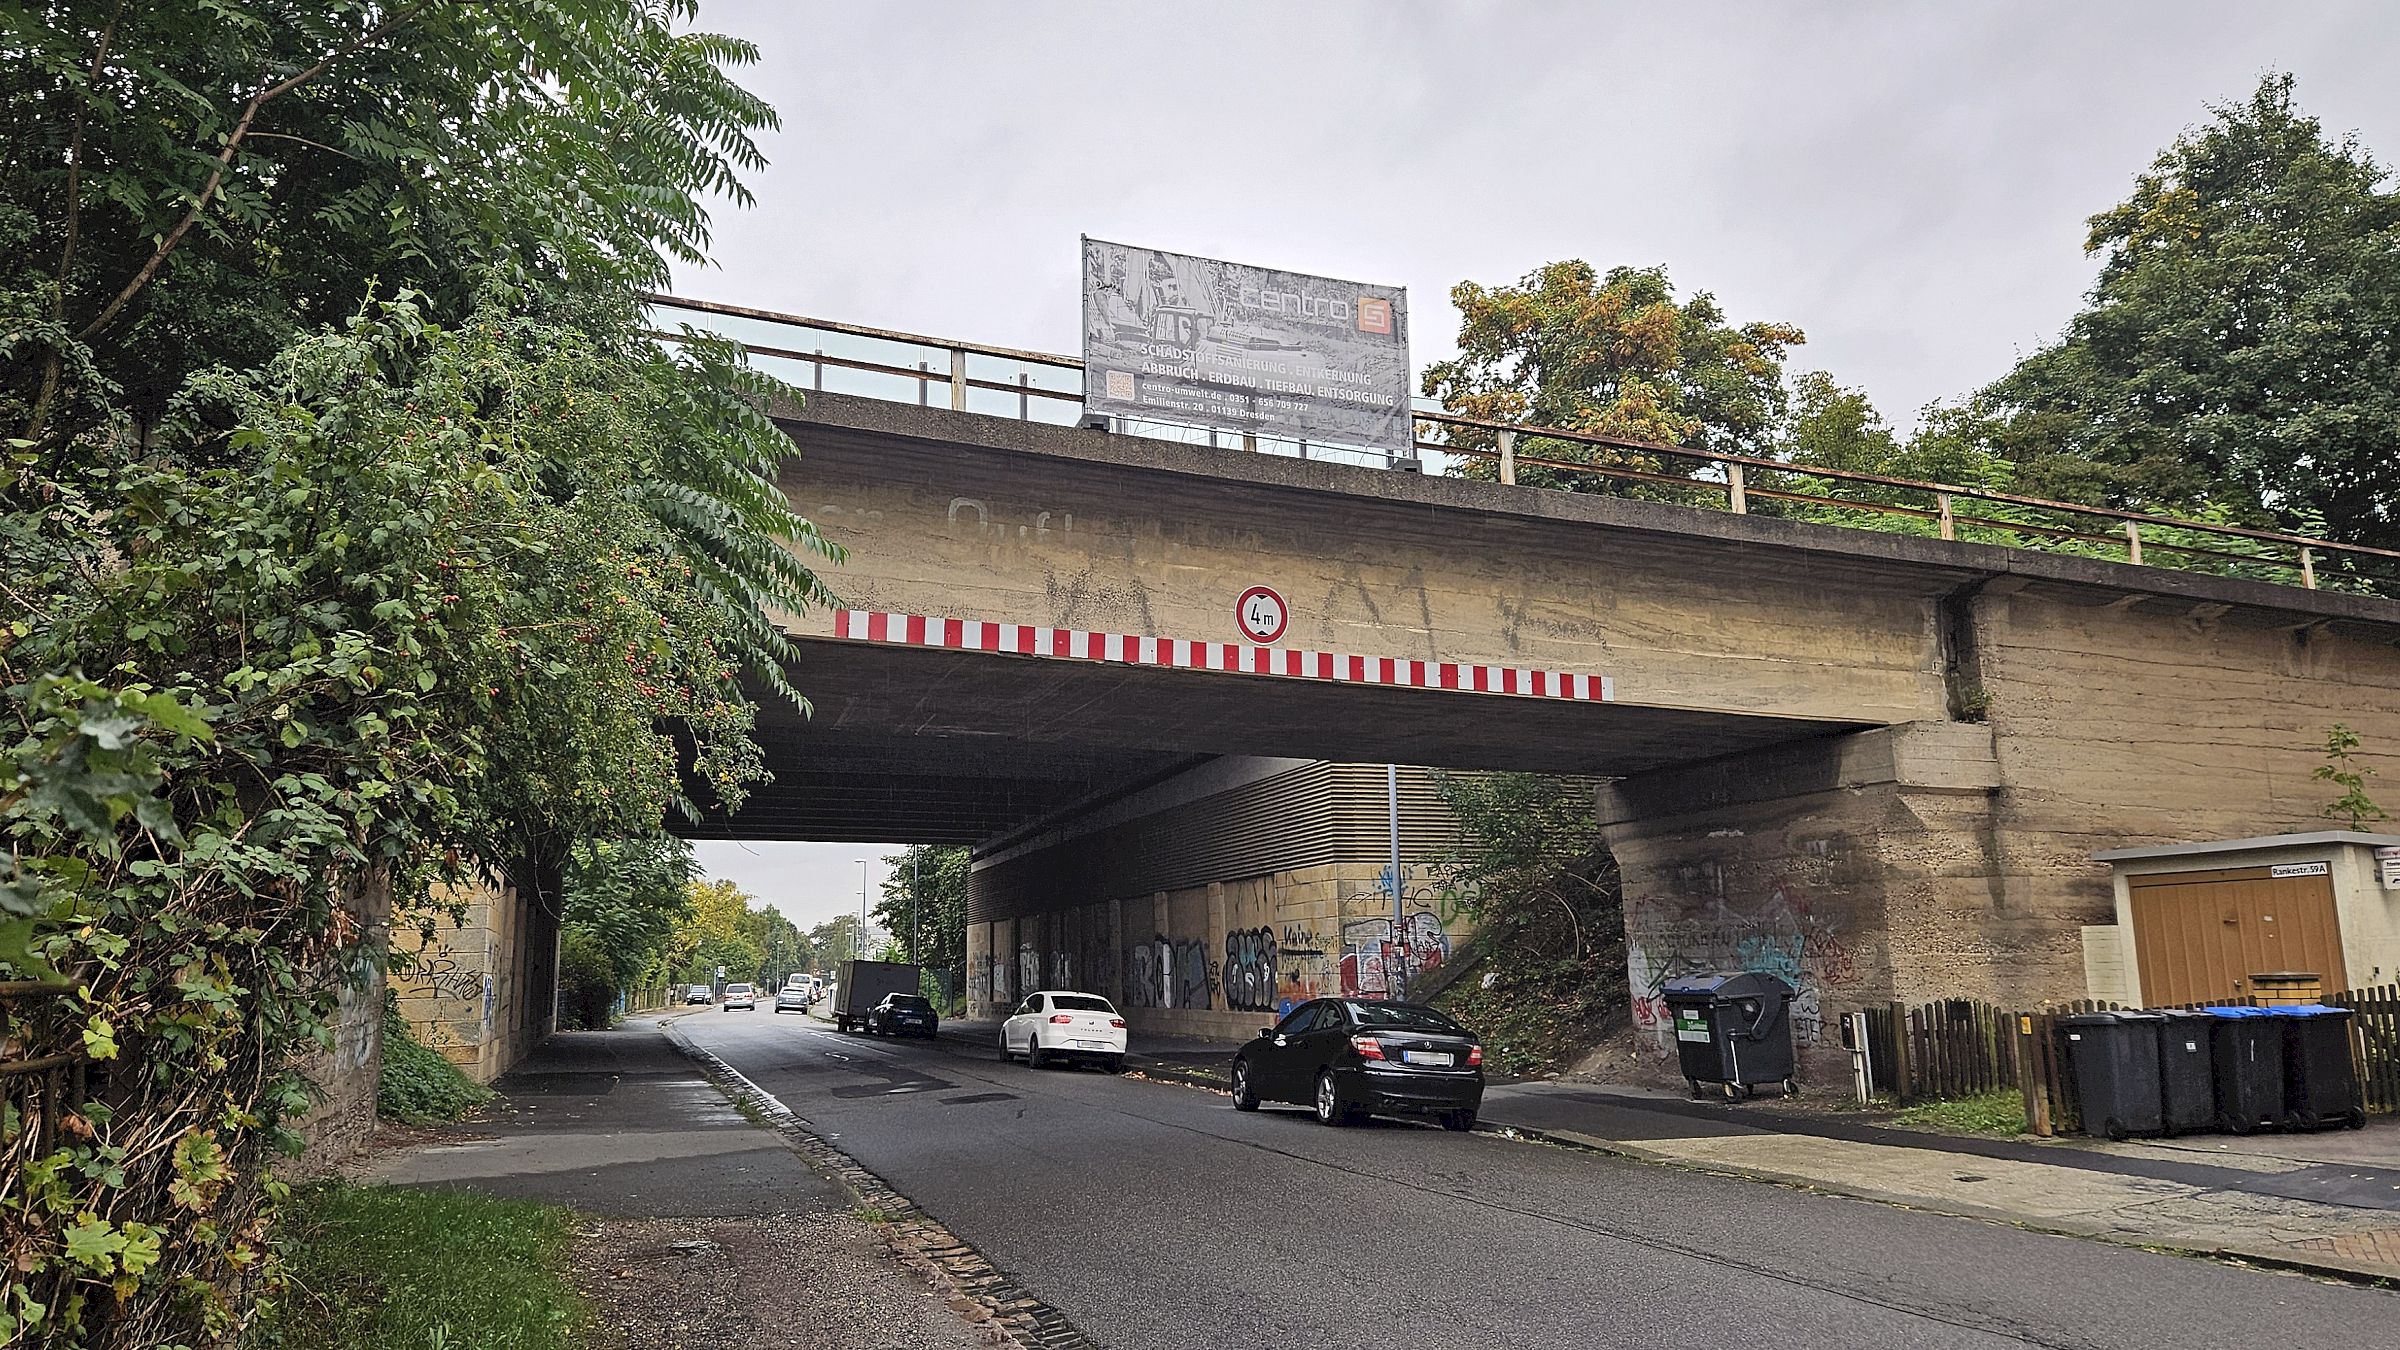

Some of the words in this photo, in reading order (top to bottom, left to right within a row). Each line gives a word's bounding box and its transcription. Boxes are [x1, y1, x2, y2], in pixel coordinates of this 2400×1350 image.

[1140, 343, 1287, 374] SCHADSTOFFSANIERUNG
[1295, 365, 1372, 386] ENTKERNUNG
[1141, 361, 1199, 381] ABBRUCH
[1208, 371, 1256, 389] ERDBAU
[1317, 386, 1394, 407] ENTSORGUNG
[1142, 382, 1222, 401] centro-umwelt.de
[1229, 393, 1249, 405] 0351
[1276, 399, 1291, 410] 709
[1293, 401, 1309, 413] 727
[1142, 395, 1189, 409] Emilienstr.
[1193, 402, 1204, 413] 20
[1211, 407, 1237, 417] 01139
[1240, 409, 1275, 422] Dresden
